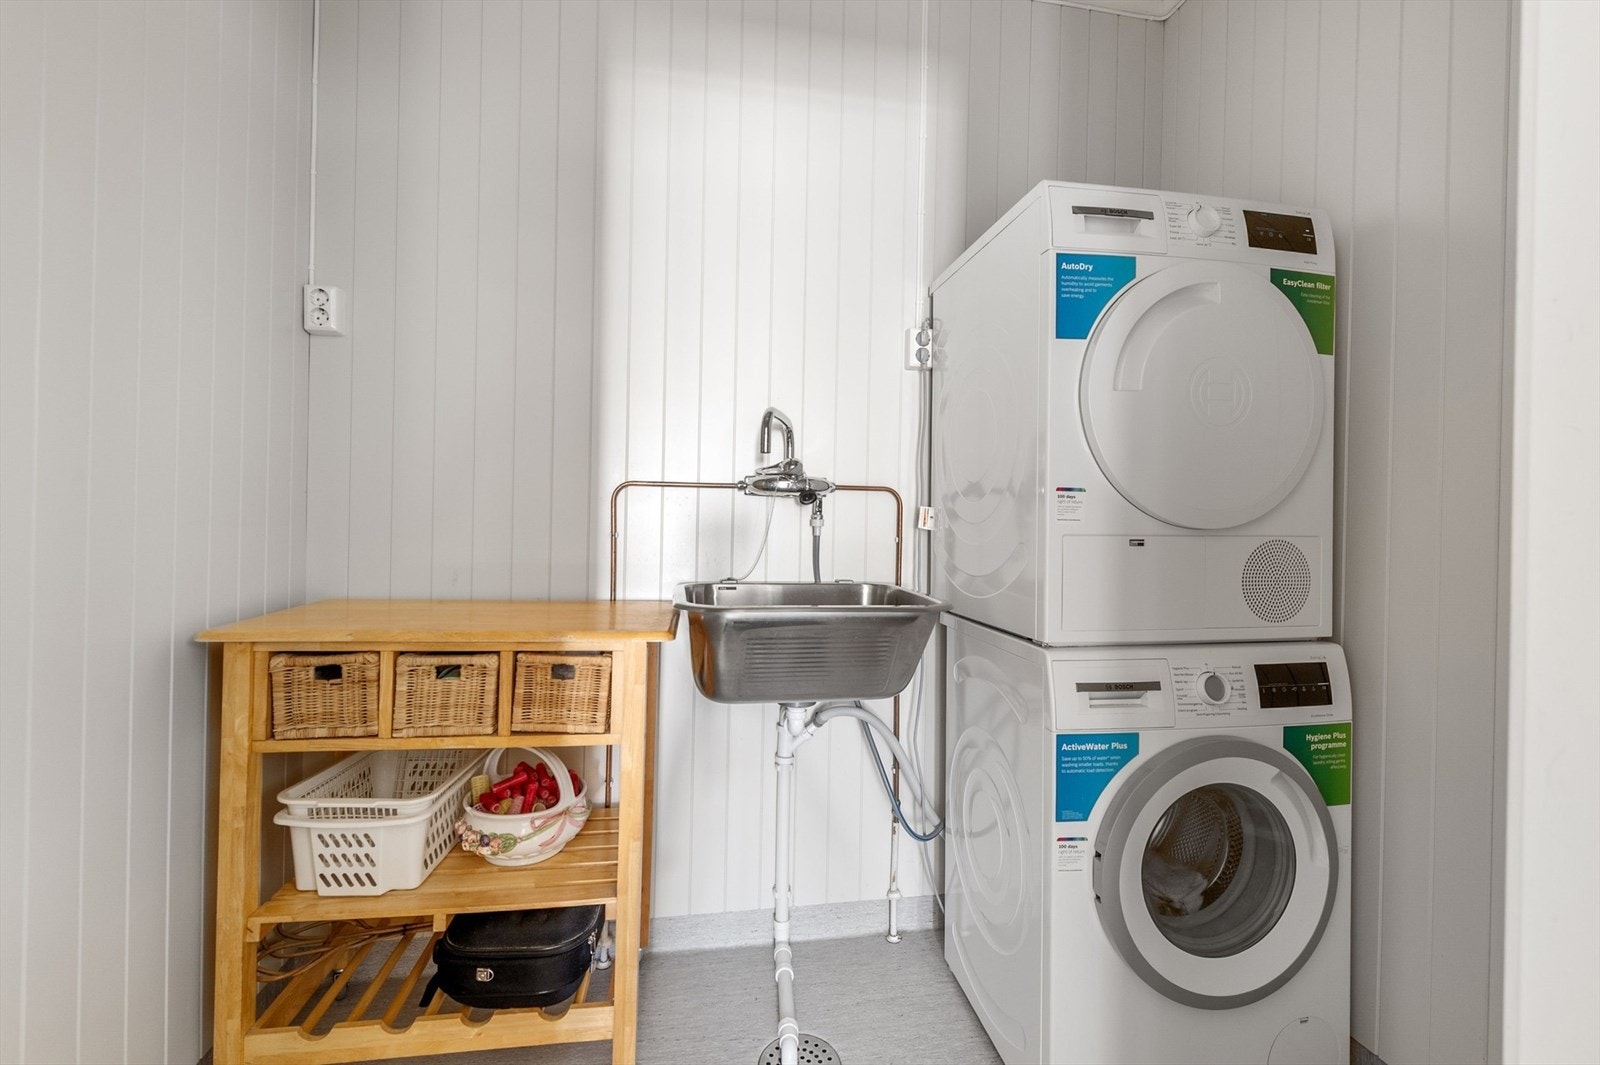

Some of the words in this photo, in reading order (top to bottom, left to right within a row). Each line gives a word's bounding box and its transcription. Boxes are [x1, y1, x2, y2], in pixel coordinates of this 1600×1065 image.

[1061, 262, 1094, 272] AutoDry
[1283, 278, 1315, 289] EasyClean
[1316, 282, 1331, 291] filter
[1306, 733, 1331, 742] Hygiene
[1061, 743, 1110, 751] ActiveWater
[1111, 742, 1128, 750] Plus
[1311, 742, 1347, 751] programme
